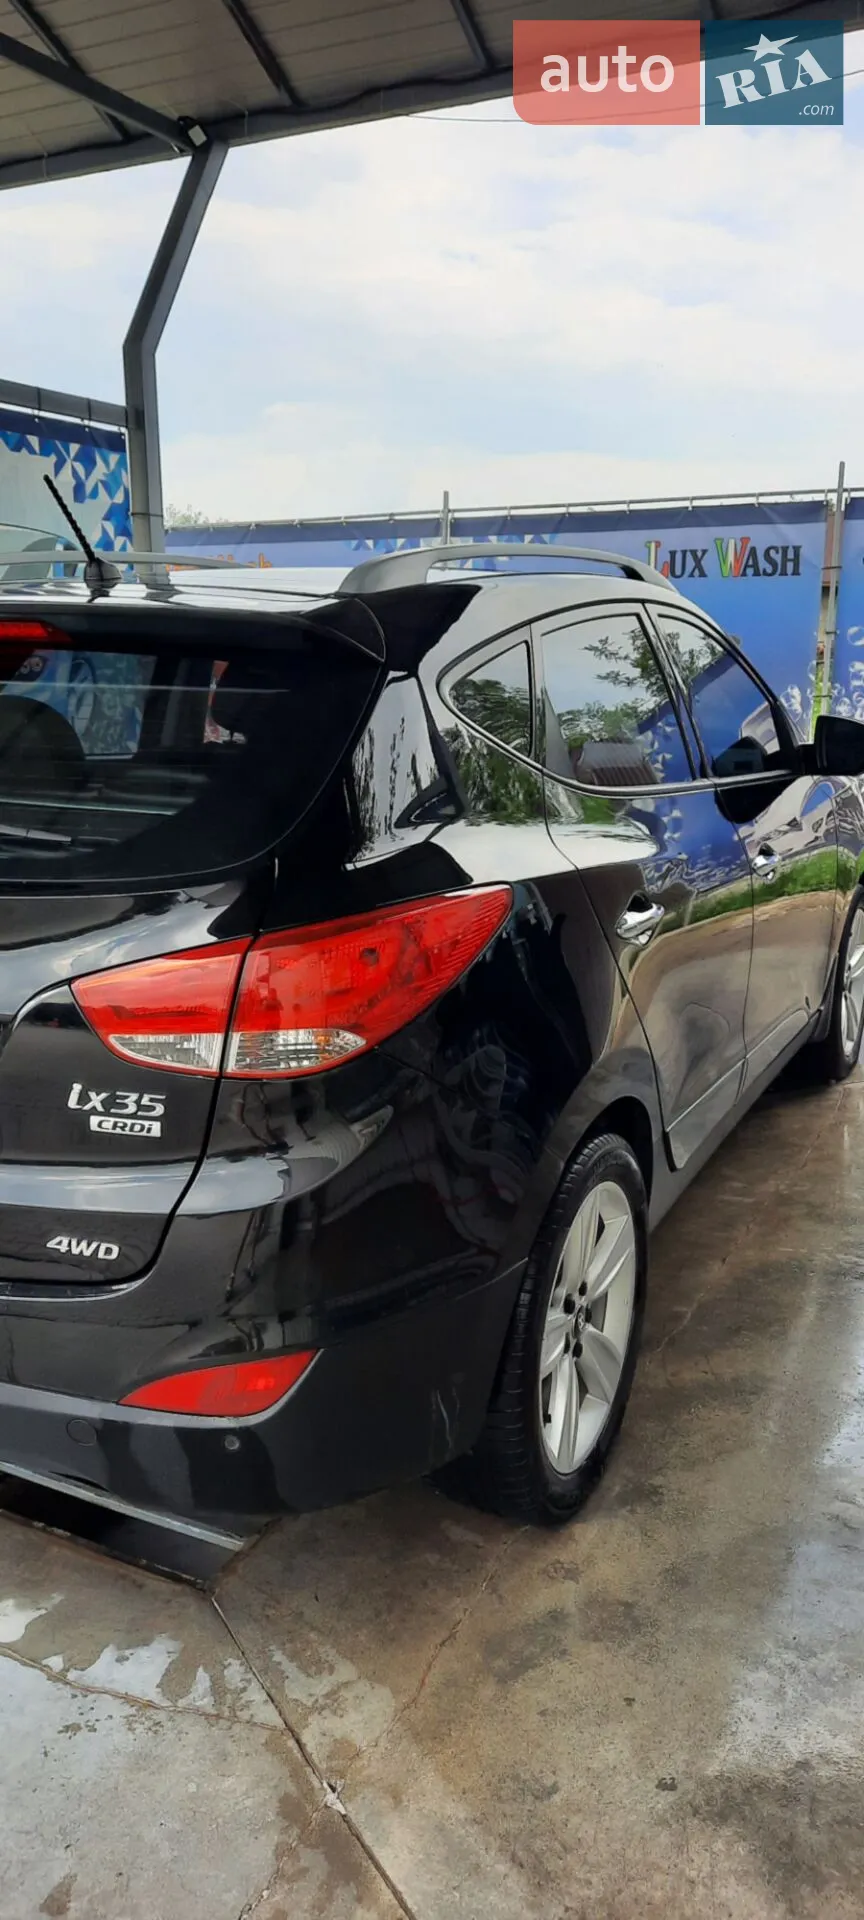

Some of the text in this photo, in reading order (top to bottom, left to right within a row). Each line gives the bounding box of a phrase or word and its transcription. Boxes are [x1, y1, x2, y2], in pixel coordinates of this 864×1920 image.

[714, 537, 802, 577] WASH
[67, 1082, 167, 1117] ix35
[96, 1118, 154, 1135] CRDi
[46, 1235, 120, 1260] 4WD
